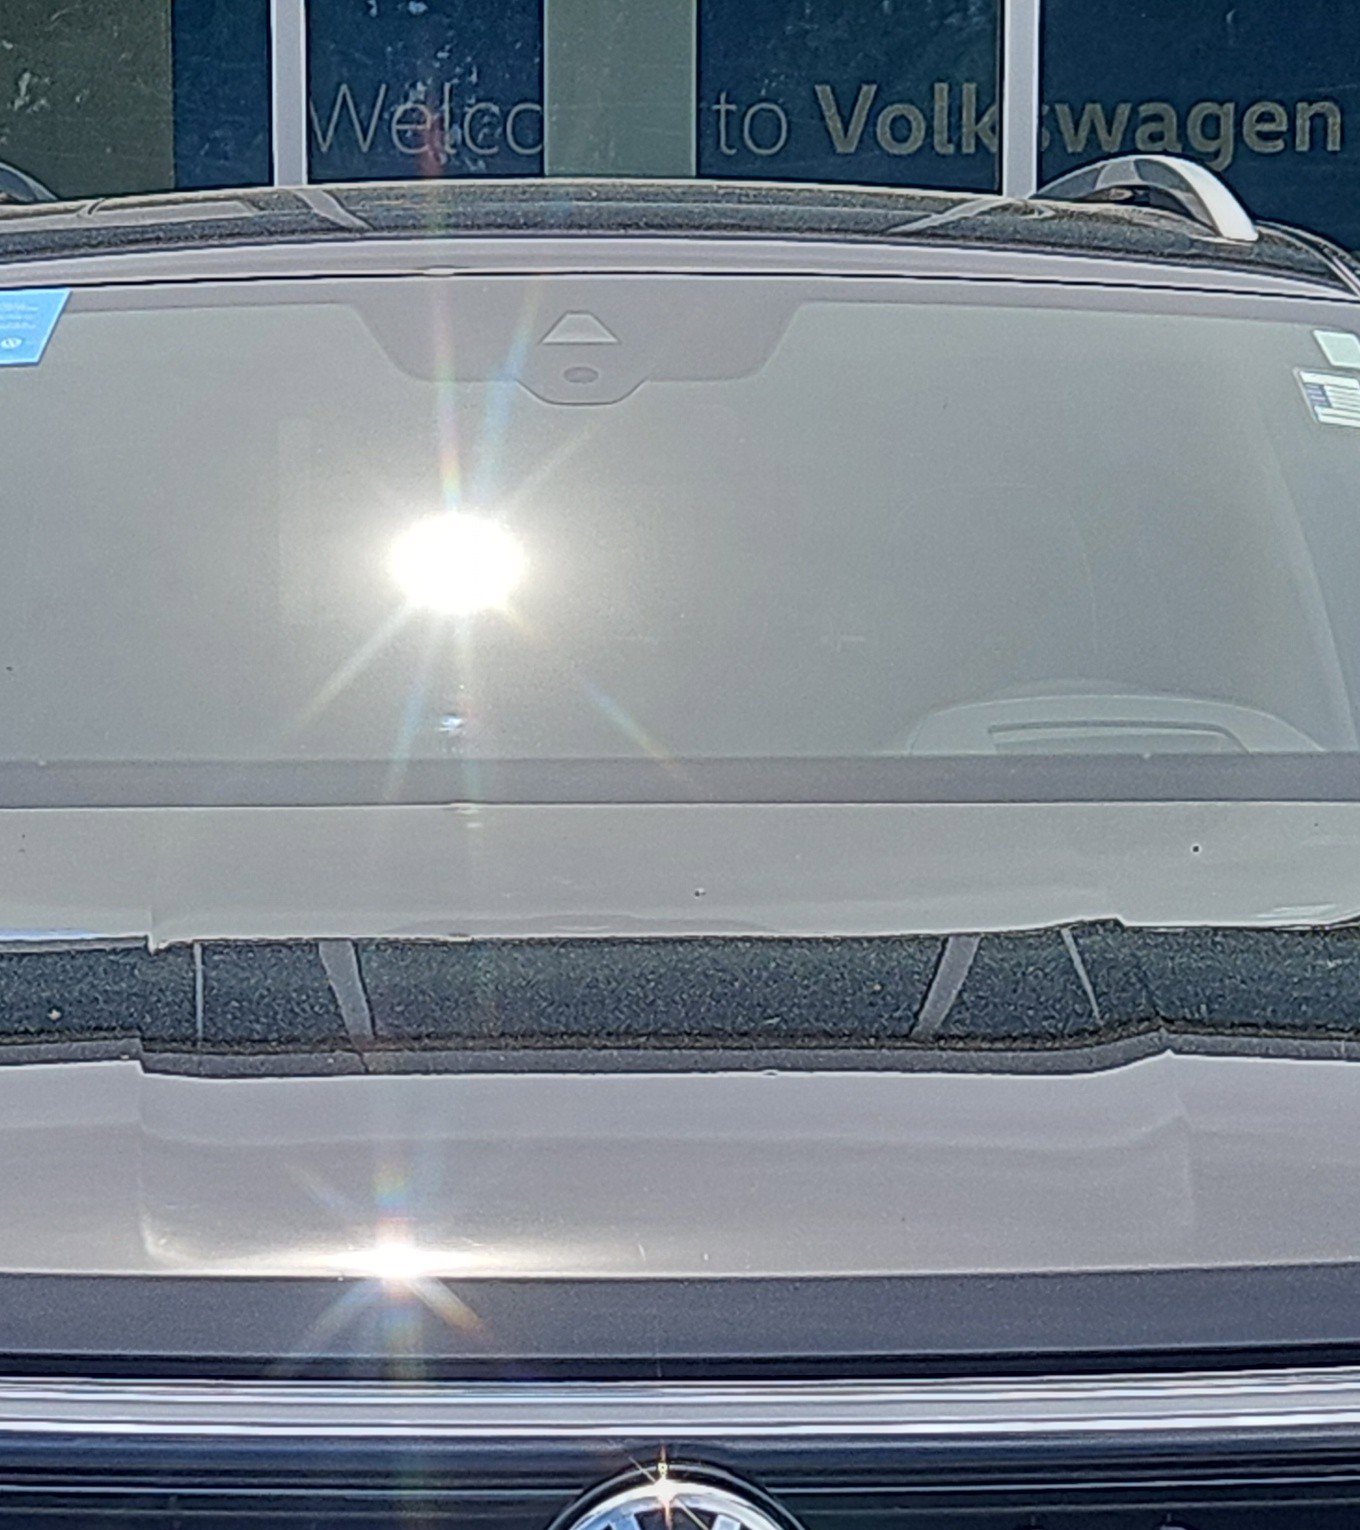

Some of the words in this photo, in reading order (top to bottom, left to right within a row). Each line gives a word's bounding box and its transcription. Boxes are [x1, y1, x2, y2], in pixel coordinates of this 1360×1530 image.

[309, 82, 544, 156] Welco
[712, 90, 789, 156] to
[815, 82, 1342, 171] Volkwagen
